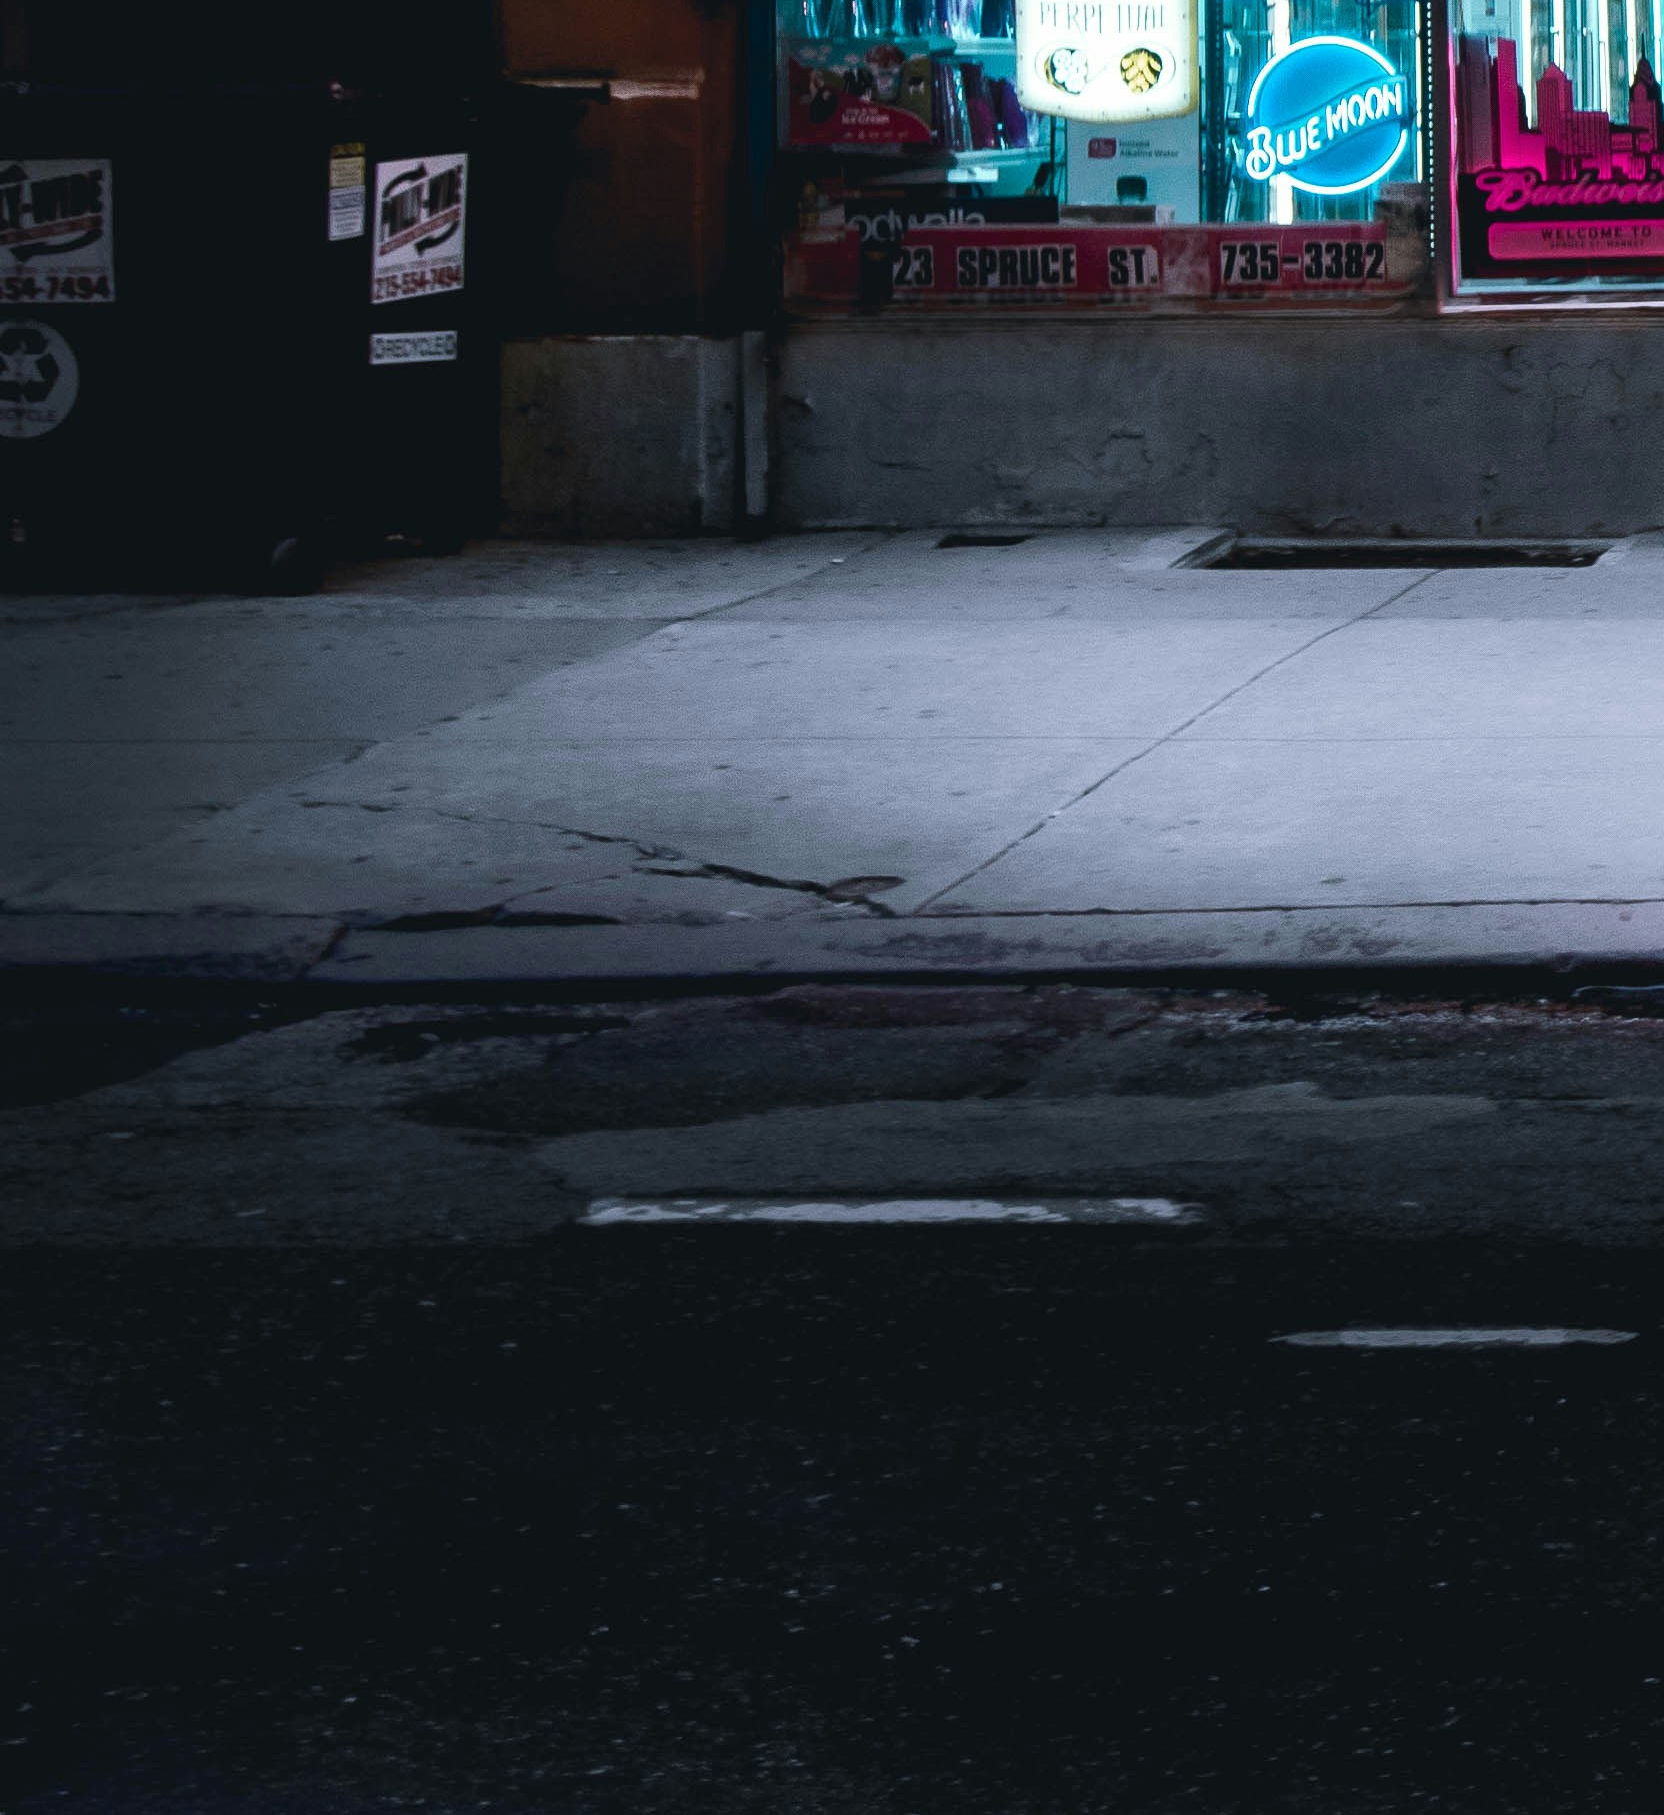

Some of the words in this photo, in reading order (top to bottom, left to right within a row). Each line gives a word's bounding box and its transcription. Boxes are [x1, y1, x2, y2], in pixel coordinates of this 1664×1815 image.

[1245, 116, 1321, 181] BLUE
[1325, 82, 1402, 141] MOON
[1541, 226, 1623, 242] WELCOME
[1631, 225, 1652, 239] TO
[957, 246, 1077, 286] SPRUCE
[1108, 246, 1159, 285] ST.
[1220, 242, 1385, 282] 735-3382
